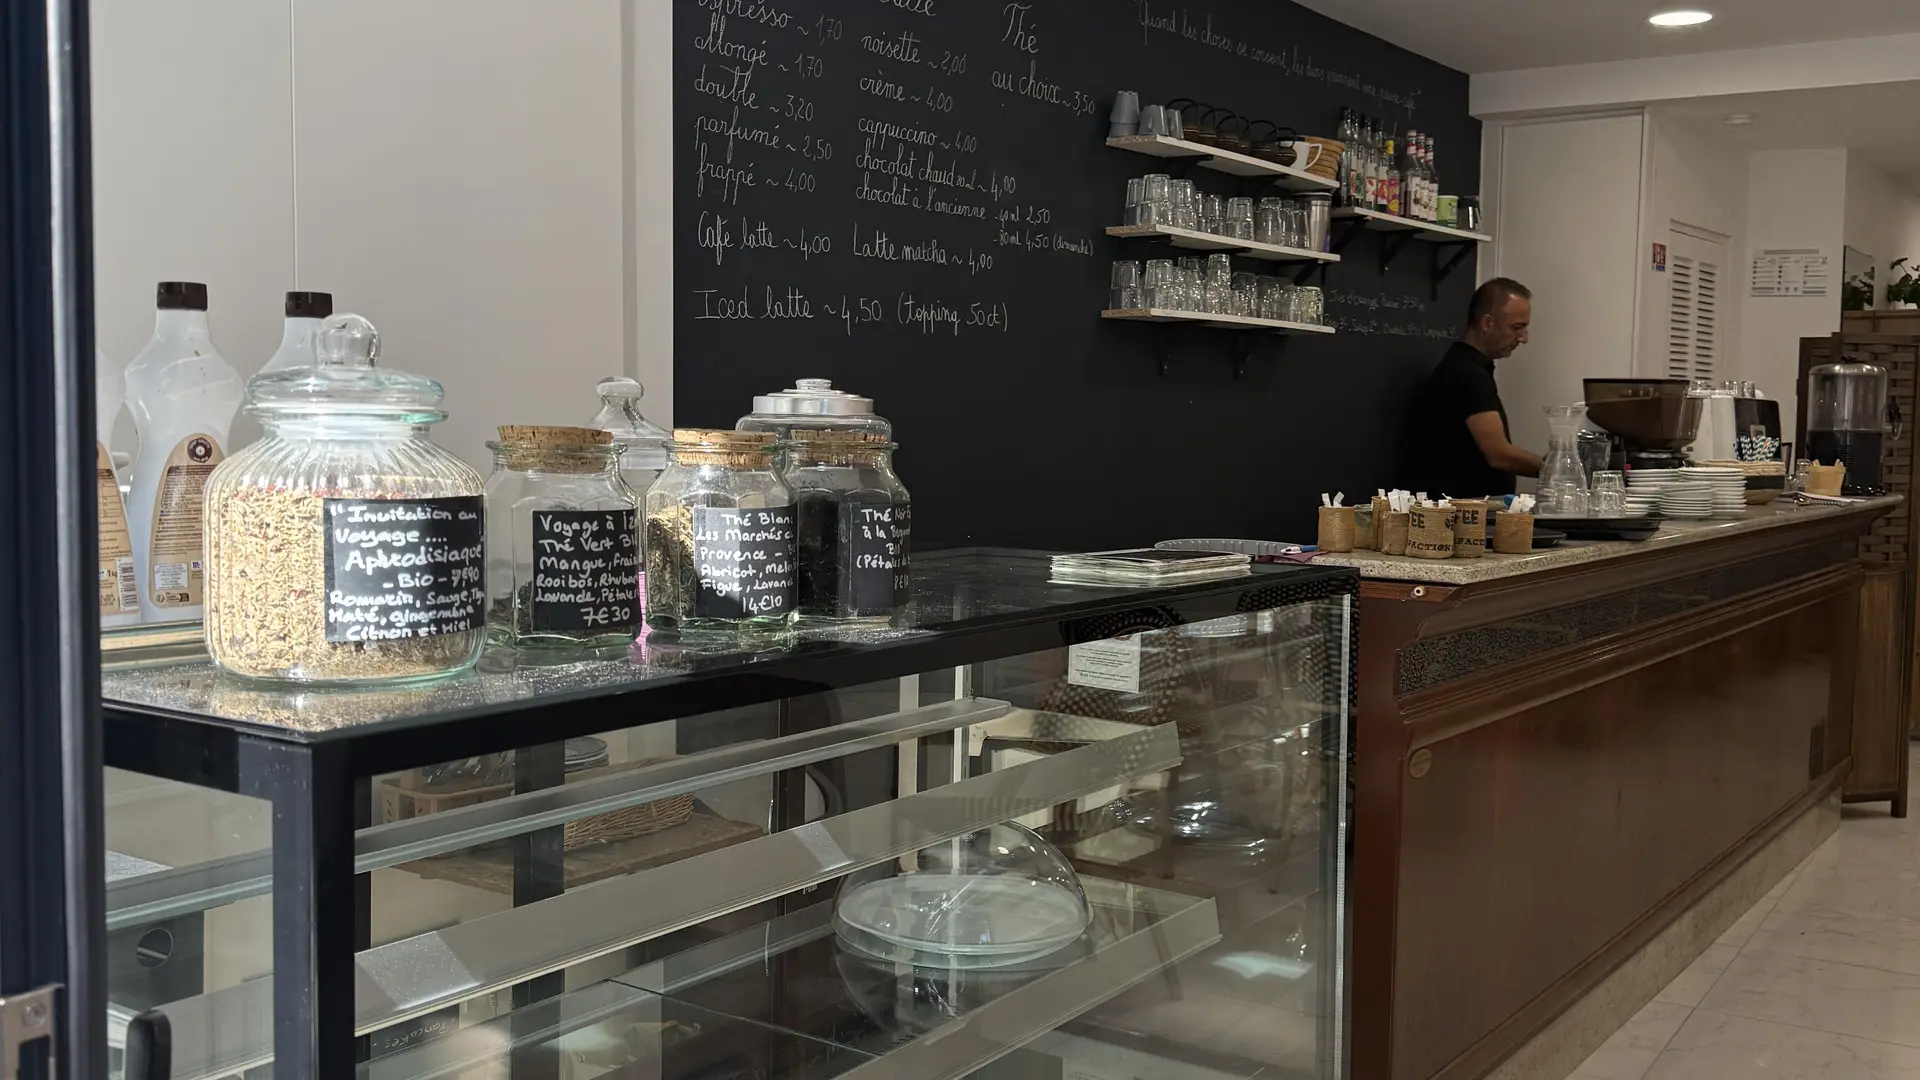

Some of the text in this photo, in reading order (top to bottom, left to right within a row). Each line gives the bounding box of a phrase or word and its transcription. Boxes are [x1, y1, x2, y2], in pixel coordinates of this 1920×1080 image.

[815, 13, 843, 46] 1,70
[1002, 2, 1039, 53] Thé
[861, 31, 921, 64] noisette
[795, 53, 823, 78] 1,70
[694, 64, 760, 109] double
[785, 94, 814, 122] 3,20
[859, 69, 906, 101] crème
[927, 86, 954, 112] 4,00
[992, 69, 1014, 92] au
[1018, 59, 1061, 104] choix
[1072, 91, 1096, 116] 3,50
[694, 105, 780, 164] parfumé
[802, 135, 832, 161] 2,50
[858, 117, 938, 150] cappuccino
[856, 138, 917, 179] chocolat
[696, 142, 757, 206] frappé
[784, 168, 816, 193] 4,00
[855, 171, 911, 206] chocolat
[698, 210, 736, 266] Café
[740, 216, 779, 250] latte
[800, 227, 832, 261] 4,00
[853, 221, 900, 260] Latte
[901, 239, 948, 266] matcha
[968, 248, 993, 276] 4,00
[693, 285, 755, 319] Iced
[760, 285, 815, 319] latte
[842, 294, 882, 336] 4,50
[898, 291, 961, 336] (topping
[458, 511, 478, 520] au
[540, 514, 600, 539] Voyage
[605, 514, 615, 531] à
[721, 512, 752, 527] Thé
[861, 508, 892, 522] Thé
[538, 538, 575, 553] Thé
[580, 536, 615, 552] Vert
[696, 527, 719, 541] Les
[862, 525, 872, 540] à
[876, 524, 887, 539] la
[700, 546, 767, 561] Provence
[397, 572, 434, 588] Bio
[536, 574, 598, 588] Rooibos,
[701, 563, 763, 579] Abricot,
[700, 578, 750, 597] Figue,
[580, 606, 631, 627] 7€30
[346, 624, 413, 641] Citron
[418, 624, 438, 637] et
